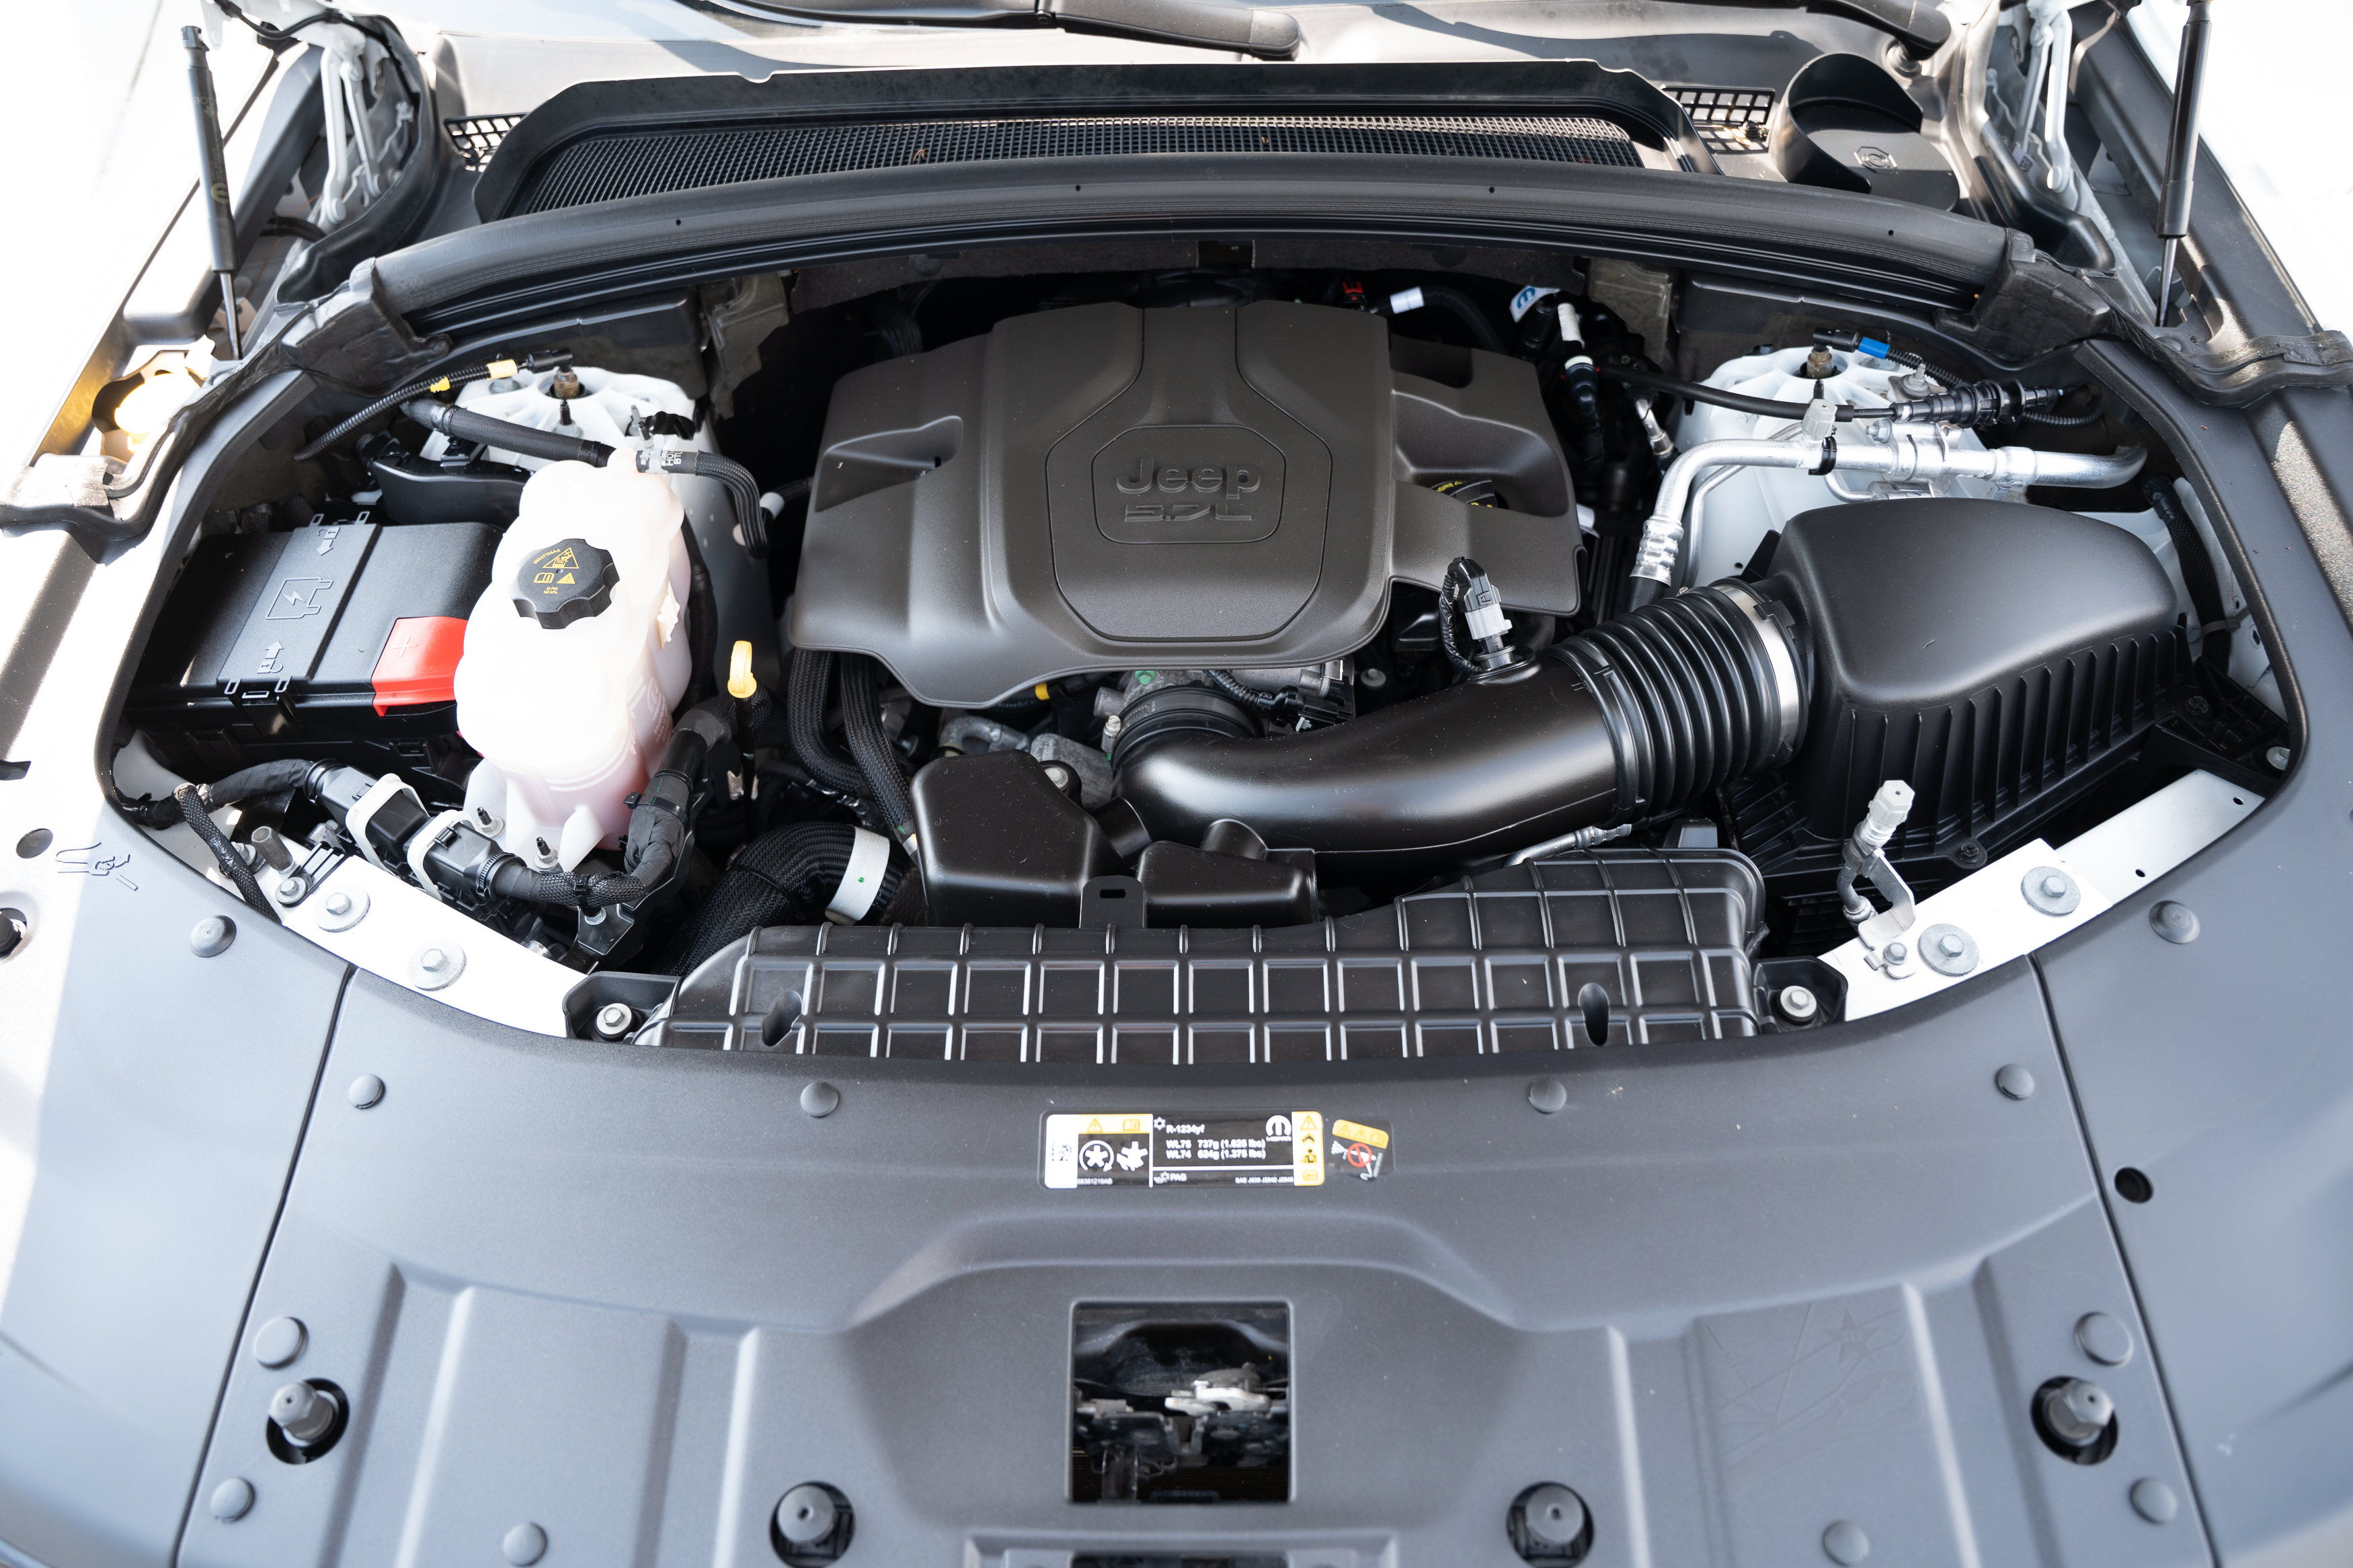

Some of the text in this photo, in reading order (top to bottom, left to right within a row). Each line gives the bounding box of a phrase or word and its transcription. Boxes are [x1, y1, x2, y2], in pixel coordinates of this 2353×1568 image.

[1116, 458, 1261, 499] Jeep
[1124, 502, 1252, 522] 5.7L
[1166, 1124, 1205, 1135] R-1234yf
[1166, 1139, 1192, 1149] WL75
[1197, 1139, 1220, 1150] 737g
[1248, 1139, 1266, 1149] lbs)
[1166, 1149, 1192, 1159] WL74
[1220, 1149, 1248, 1160] (1.375
[1248, 1149, 1267, 1159] lbs)
[1170, 1173, 1187, 1182] PAG
